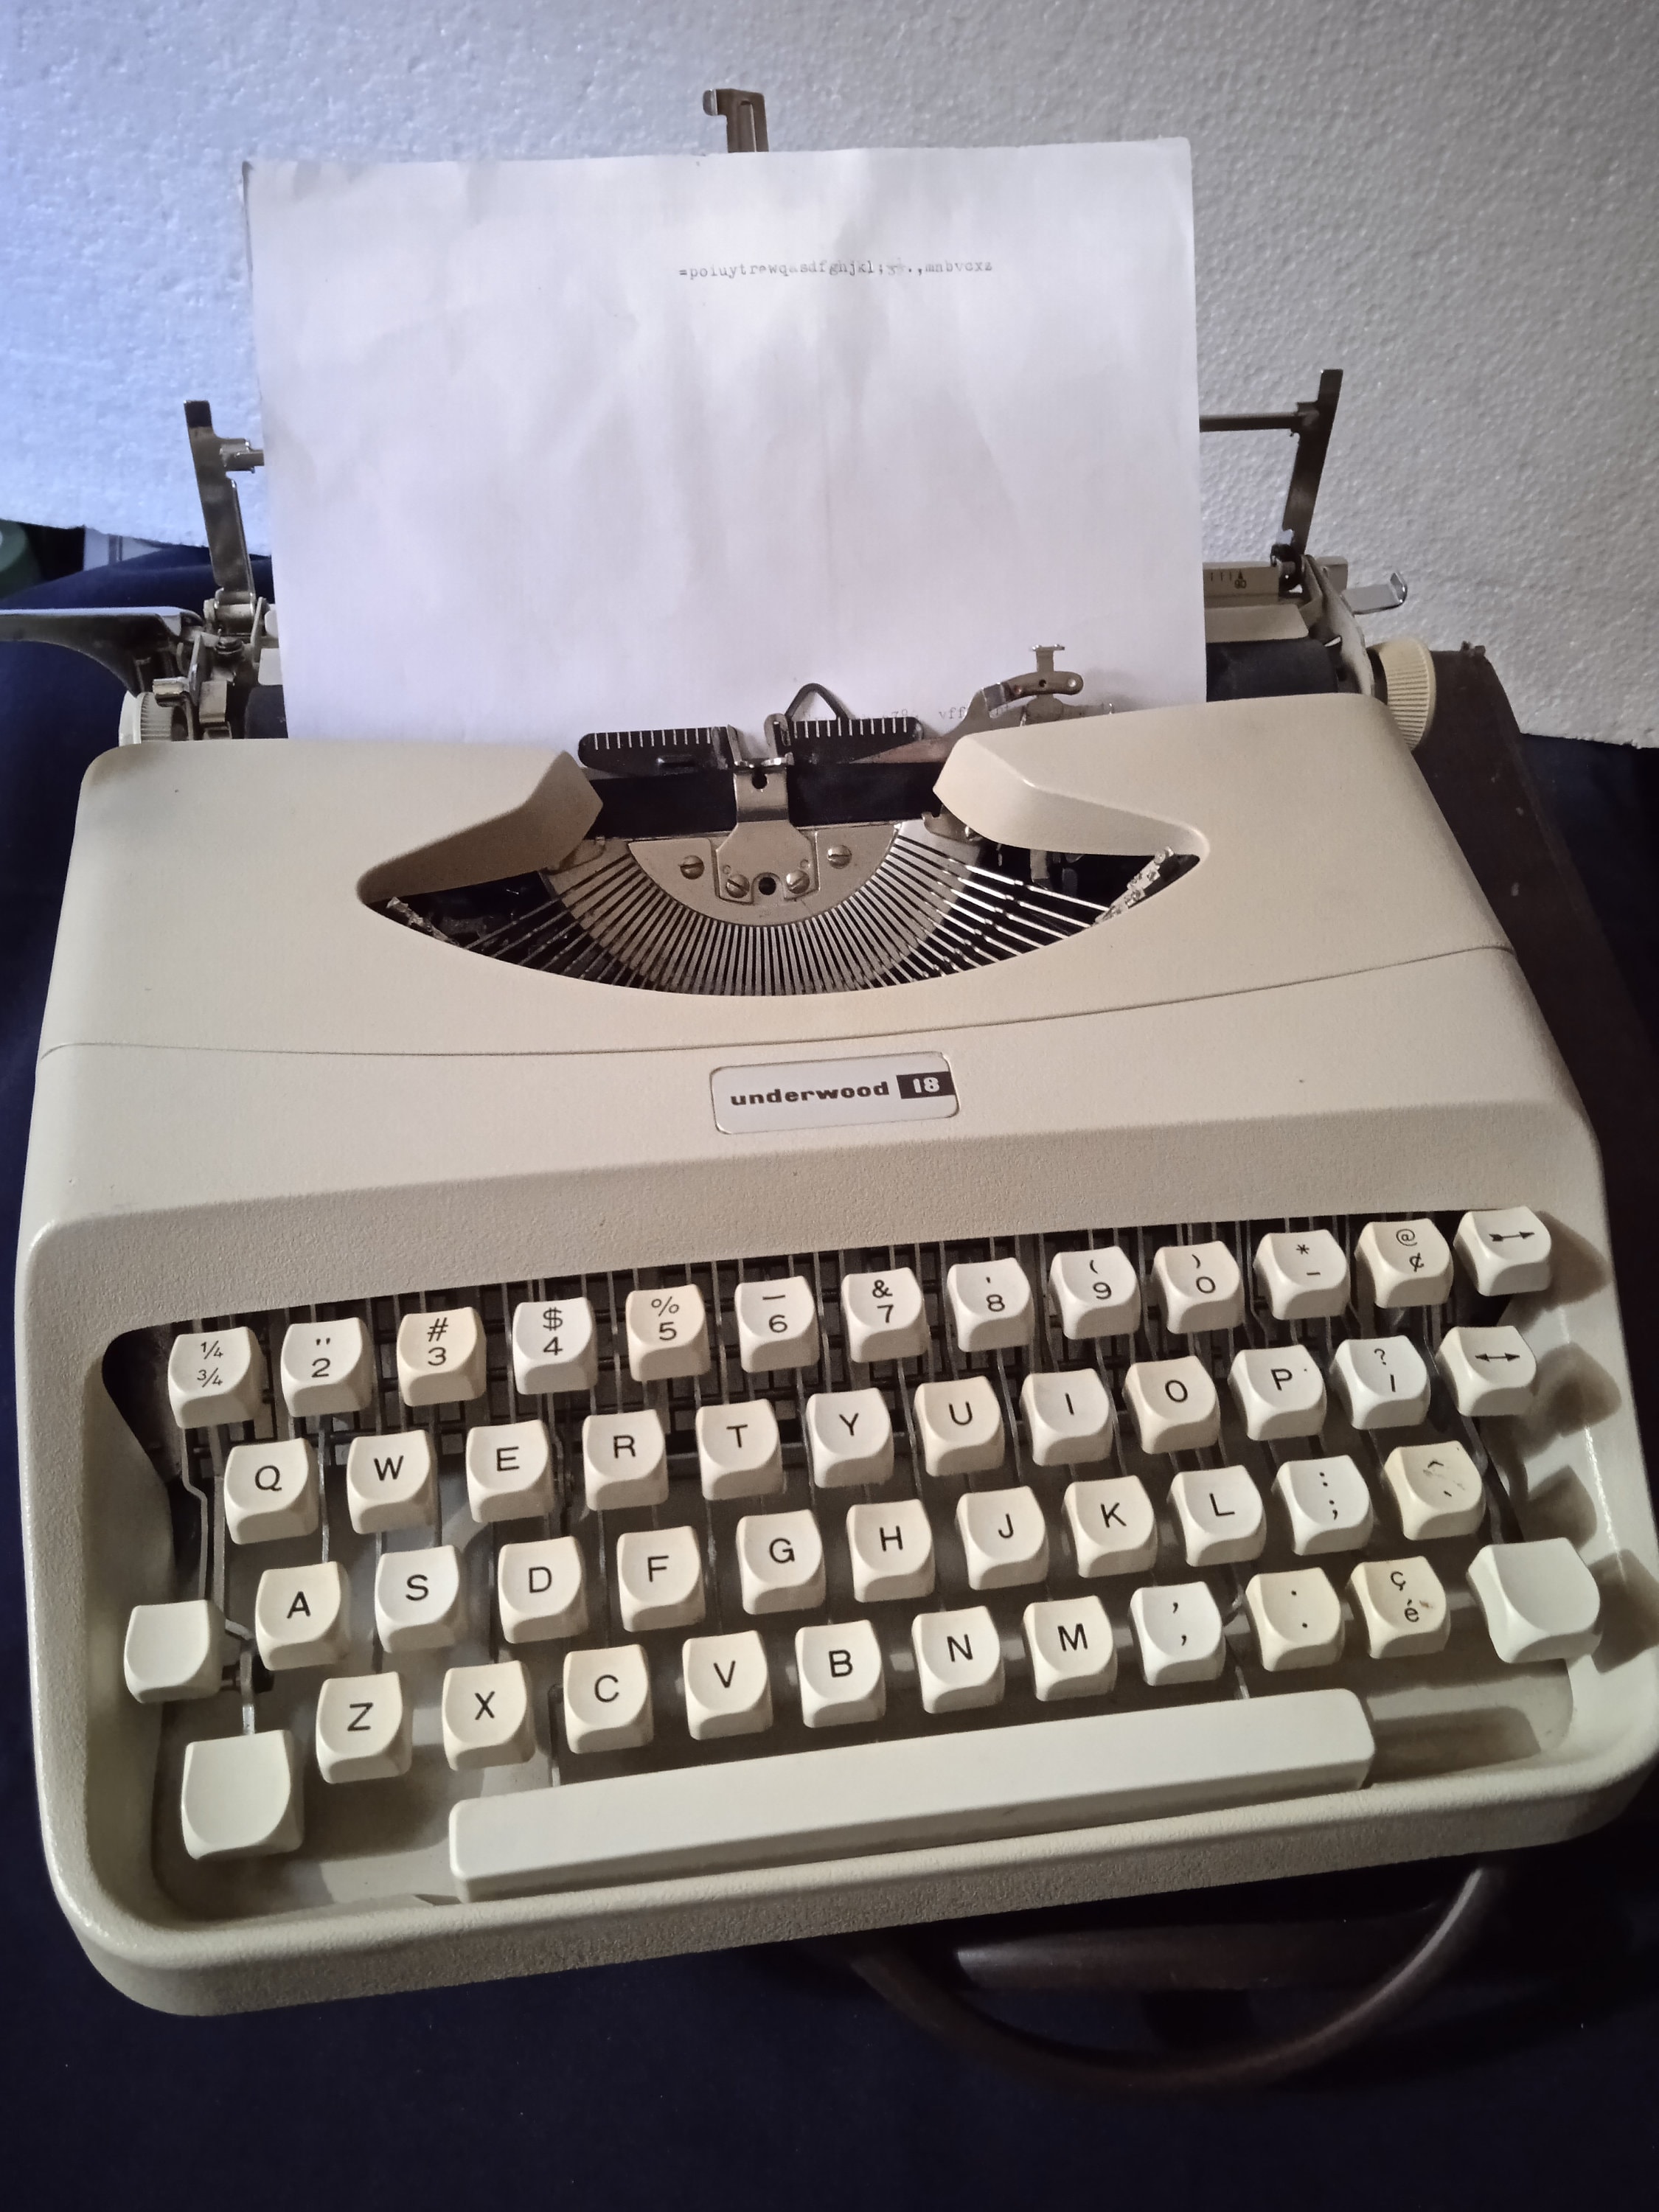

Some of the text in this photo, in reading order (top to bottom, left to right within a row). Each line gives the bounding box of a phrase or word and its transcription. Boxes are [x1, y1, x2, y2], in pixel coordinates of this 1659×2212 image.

[730, 1076, 941, 1106] underwood 18
[1395, 1228, 1417, 1247] @
[872, 1279, 893, 1298] &
[1093, 1281, 1112, 1300] 9
[650, 1295, 680, 1317] %
[877, 1304, 894, 1324] 7
[986, 1294, 1006, 1312] 8
[427, 1317, 448, 1343] #
[543, 1307, 563, 1331] $
[658, 1321, 677, 1341] 5
[768, 1314, 788, 1333] 6
[428, 1346, 447, 1366] 3
[543, 1336, 563, 1356] 4
[1374, 1348, 1387, 1366] ?
[311, 1357, 331, 1378] 2
[1270, 1368, 1293, 1391] P
[1164, 1380, 1189, 1403] O
[838, 1413, 859, 1436] Y
[948, 1402, 973, 1426] U
[613, 1435, 636, 1459] R
[726, 1424, 748, 1448] T
[373, 1455, 404, 1481] W
[496, 1446, 520, 1472] E
[254, 1465, 282, 1492] Q
[1100, 1502, 1127, 1528] K
[1209, 1492, 1235, 1517] L
[998, 1513, 1014, 1539] J
[769, 1538, 796, 1564] G
[879, 1526, 903, 1552] H
[528, 1566, 552, 1594] D
[647, 1555, 669, 1582] F
[406, 1574, 429, 1601] S
[286, 1591, 311, 1619] A
[947, 1634, 973, 1663] N
[1057, 1623, 1088, 1652] M
[713, 1660, 736, 1688] V
[828, 1649, 853, 1678] B
[594, 1674, 619, 1703] C
[347, 1702, 373, 1732] Z
[474, 1691, 495, 1721] X
